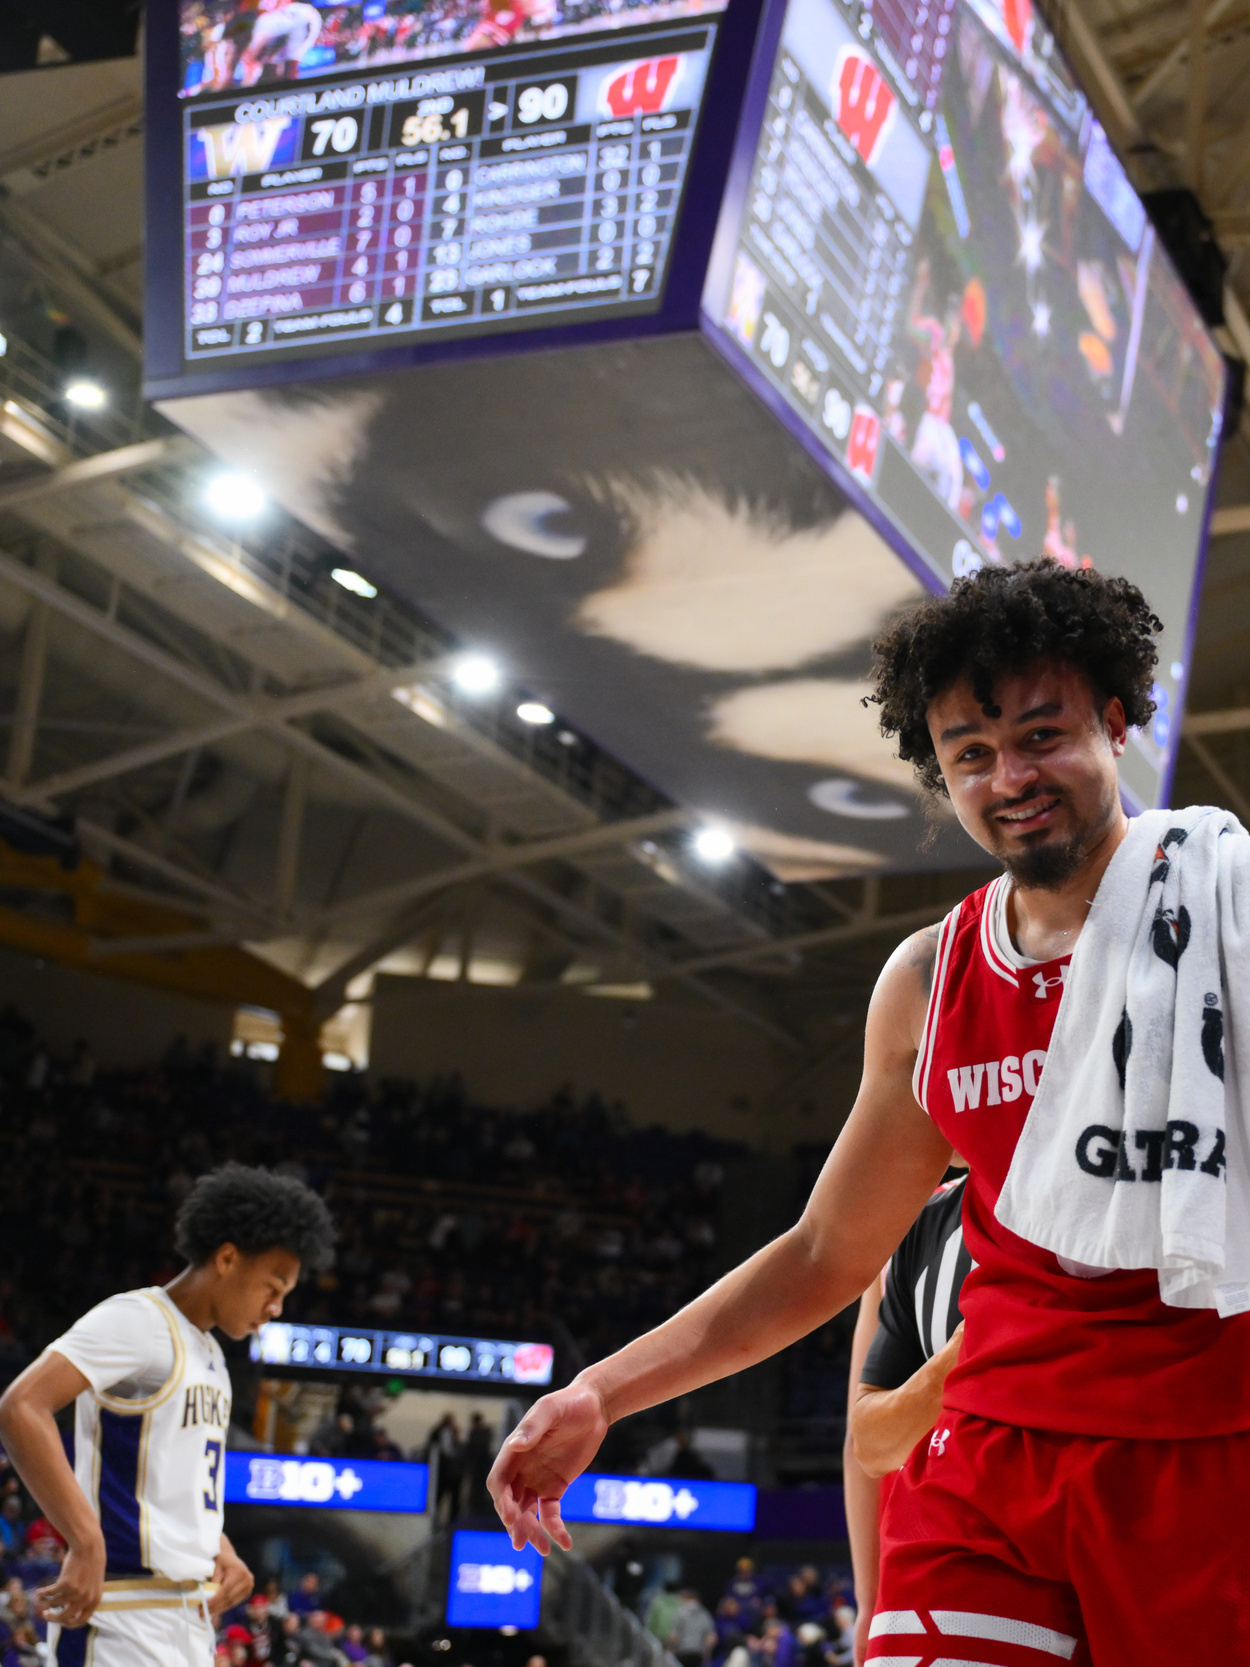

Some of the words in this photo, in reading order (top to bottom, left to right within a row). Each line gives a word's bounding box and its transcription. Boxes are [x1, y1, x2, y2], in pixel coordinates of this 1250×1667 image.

[197, 115, 292, 180] W
[311, 116, 358, 156] 70
[518, 83, 568, 124] 90
[604, 55, 681, 119] W
[234, 85, 366, 124] COURTLAND
[401, 107, 470, 146] 56.1
[445, 169, 463, 192] 0
[647, 140, 661, 162] 1
[602, 168, 621, 192] 0
[642, 163, 661, 187] 0
[403, 175, 416, 198] 1
[356, 204, 375, 228] 2
[441, 218, 458, 241] 7
[598, 219, 617, 244] 0
[637, 214, 657, 238] 0
[356, 230, 372, 253] 7
[595, 246, 614, 270] 2
[635, 240, 655, 265] 2
[351, 255, 369, 277] 4
[394, 250, 408, 272] 1
[392, 275, 406, 297] 1
[490, 288, 505, 311] 1
[631, 268, 650, 293] 7
[384, 302, 403, 325] 4
[760, 311, 790, 368] 70
[947, 1049, 1049, 1113] WISC
[203, 1437, 223, 1514] 3
